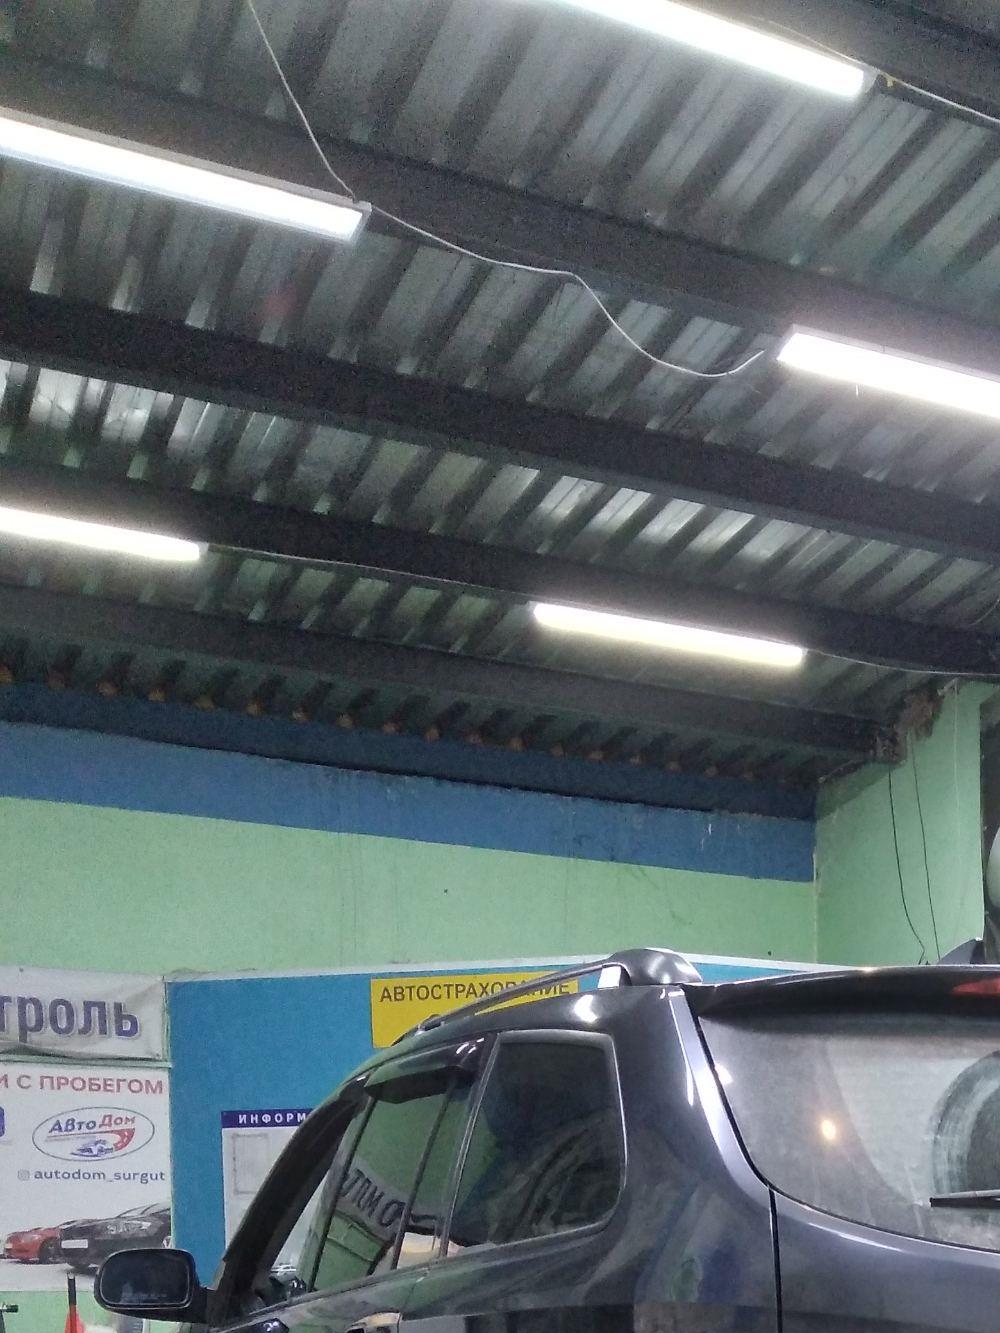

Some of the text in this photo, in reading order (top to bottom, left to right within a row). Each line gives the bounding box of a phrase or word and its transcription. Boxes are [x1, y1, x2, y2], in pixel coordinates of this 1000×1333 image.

[16, 1075, 32, 1090] С
[39, 1075, 164, 1095] ПРОБЕГОМ
[33, 1169, 166, 1185] autodom_surgut
